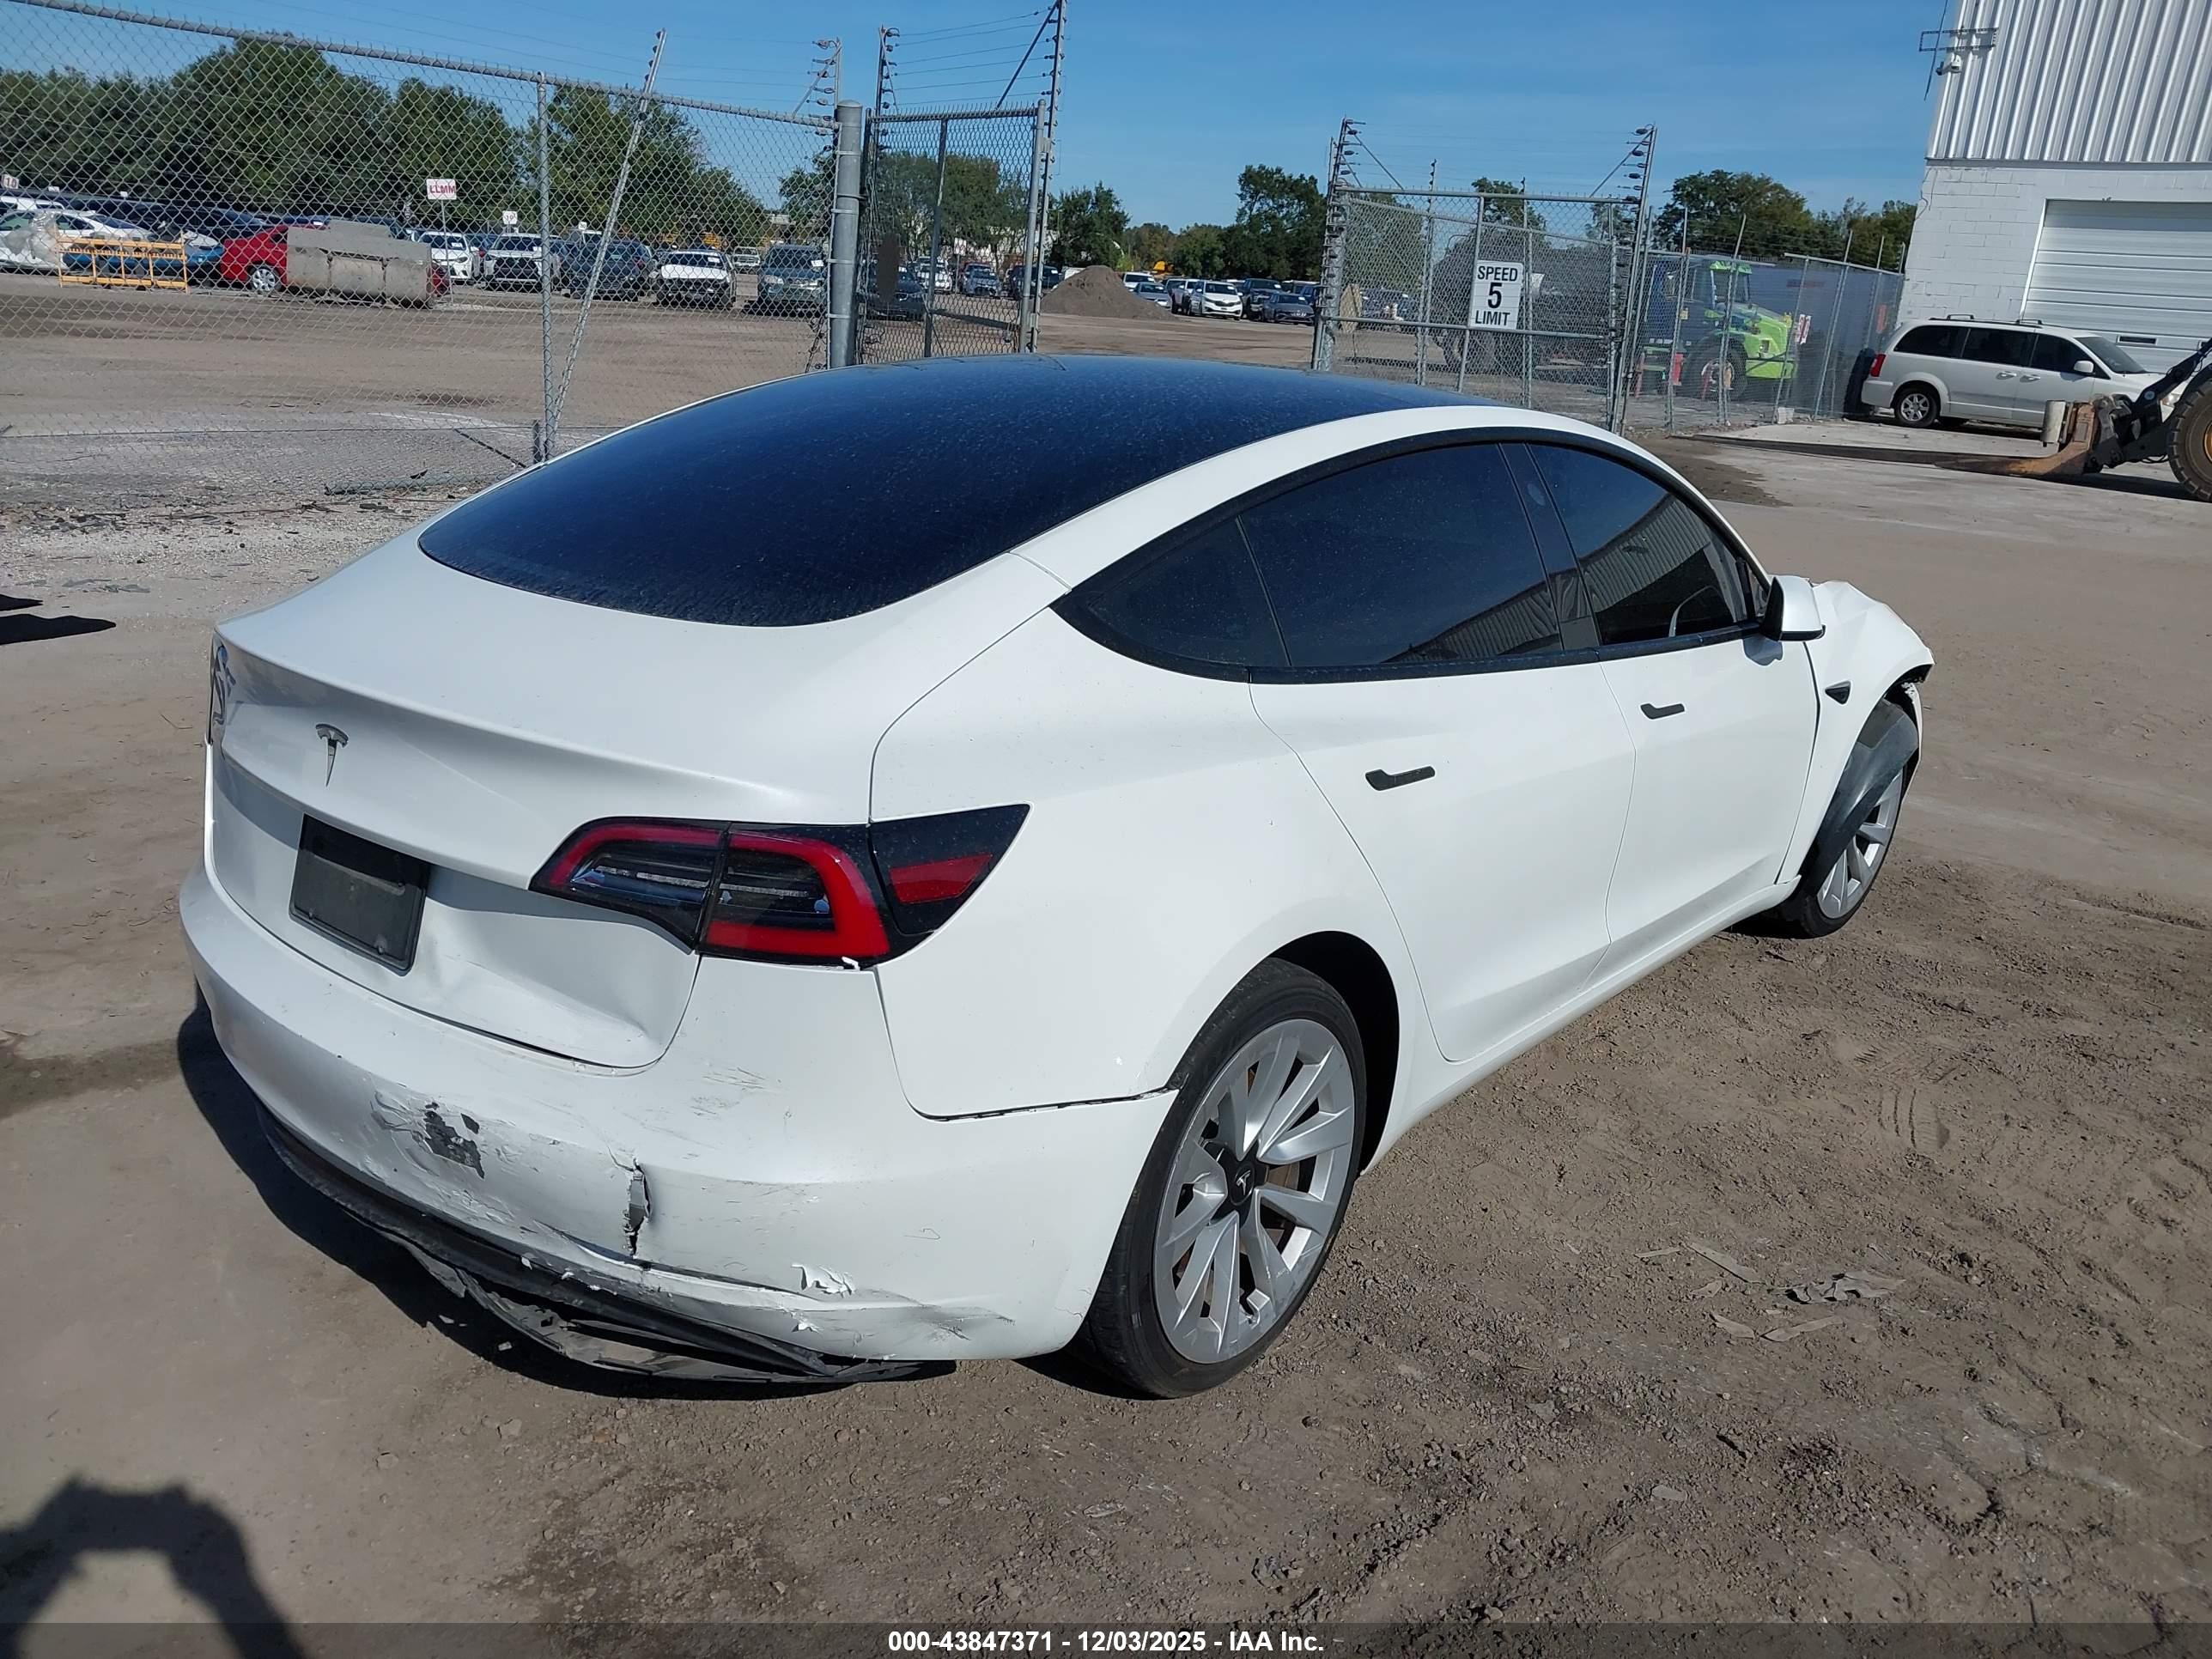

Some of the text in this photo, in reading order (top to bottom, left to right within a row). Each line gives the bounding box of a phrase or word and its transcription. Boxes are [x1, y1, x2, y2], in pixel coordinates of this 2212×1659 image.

[1477, 265, 1518, 282] SPEED
[1487, 282, 1503, 309] 5
[1474, 310, 1511, 326] LIMIT
